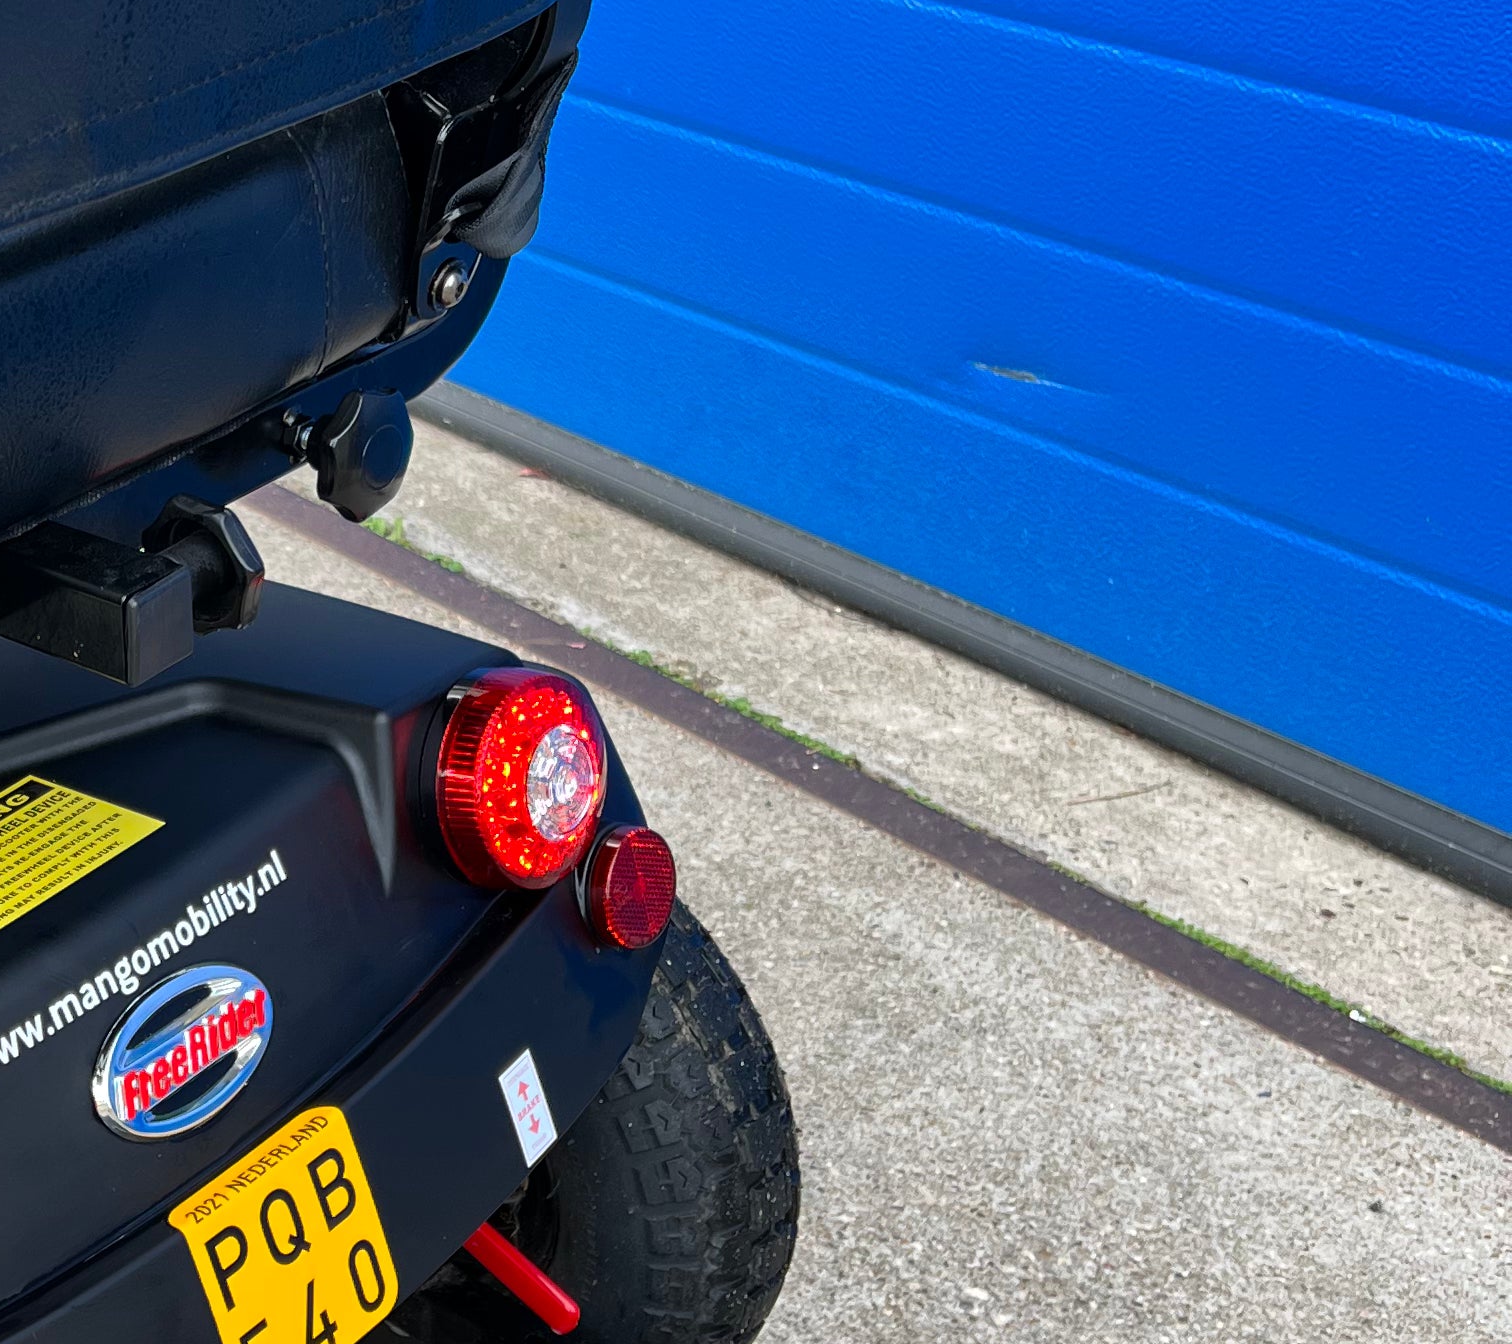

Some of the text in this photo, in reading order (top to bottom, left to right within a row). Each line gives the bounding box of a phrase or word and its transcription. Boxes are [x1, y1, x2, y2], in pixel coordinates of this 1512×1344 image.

[3, 849, 19, 857] IN
[15, 837, 39, 850] THE
[35, 800, 98, 838] DISENGAGED
[22, 790, 72, 817] DEVICE
[36, 808, 64, 824] WITH
[61, 796, 84, 808] THE
[54, 831, 92, 853] DEVICE
[88, 812, 123, 832] AFTER
[12, 831, 69, 865] RE-ENGAGE
[66, 819, 89, 832] THE
[16, 881, 34, 891] TO
[30, 857, 73, 882] COMPLY
[68, 842, 97, 858] WITH
[94, 827, 121, 842] THIS
[12, 894, 38, 909] MAY
[33, 870, 76, 895] RESULT
[71, 863, 88, 871] IN
[83, 839, 124, 864] INJURY.
[116, 988, 266, 1121] FreeRider
[185, 1114, 329, 1224] 2021 NEDERLAND
[204, 1147, 356, 1312] PQB
